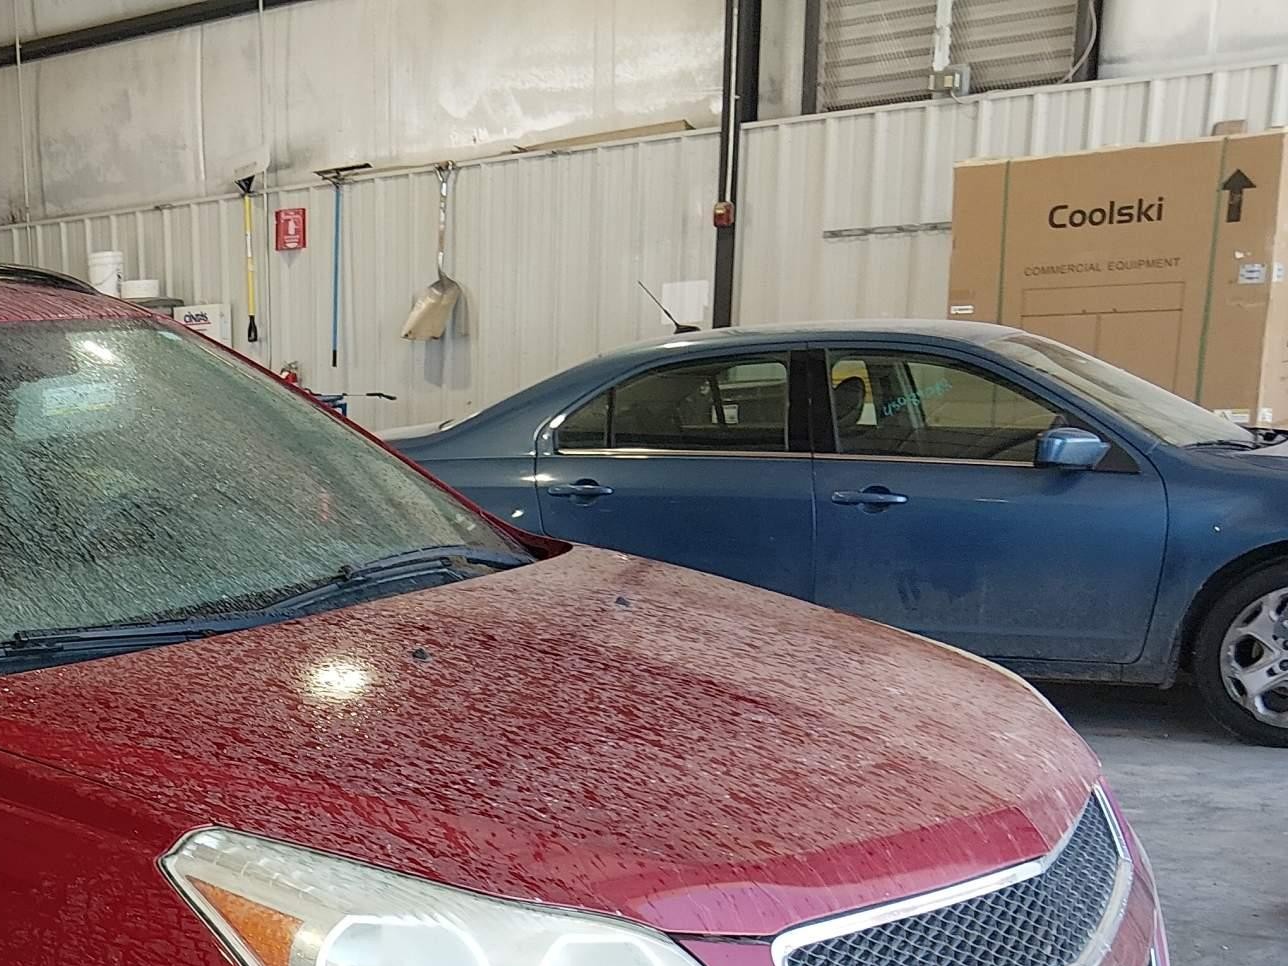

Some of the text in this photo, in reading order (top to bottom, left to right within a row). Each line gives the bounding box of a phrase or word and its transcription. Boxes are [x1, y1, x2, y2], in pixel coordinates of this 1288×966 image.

[1049, 197, 1164, 228] Coolski
[1023, 257, 1181, 277] COMMERCIAL EQUIPMENT
